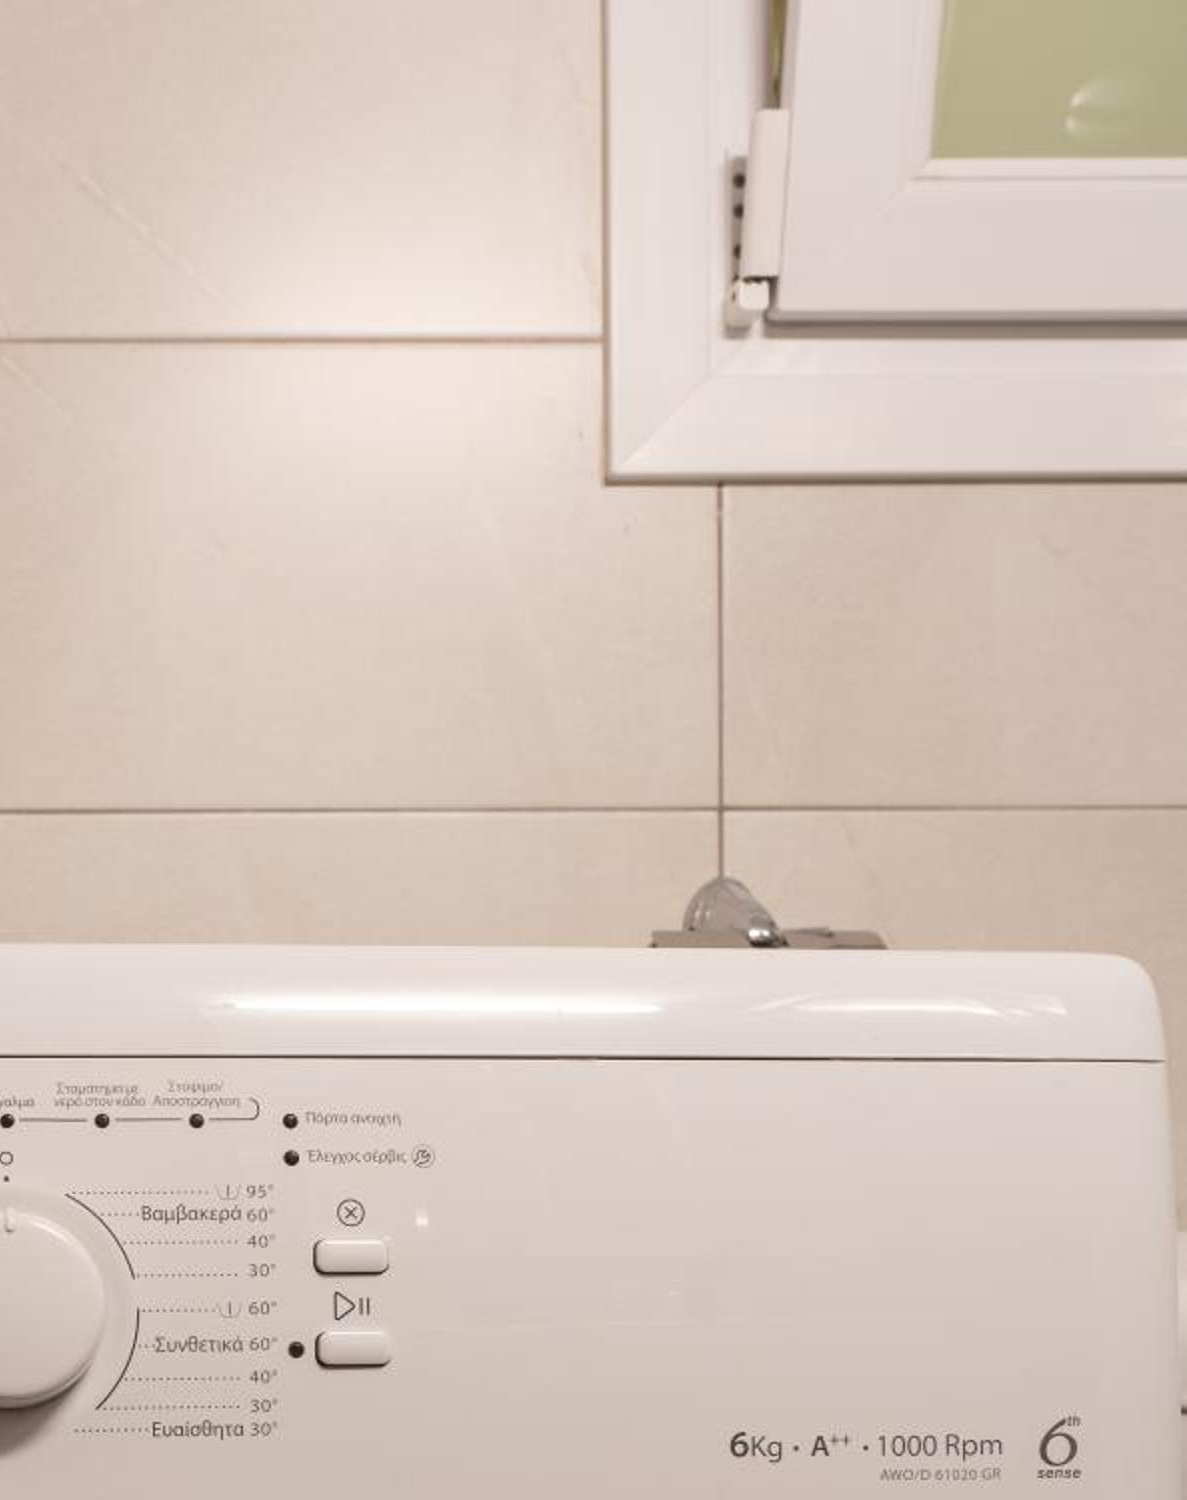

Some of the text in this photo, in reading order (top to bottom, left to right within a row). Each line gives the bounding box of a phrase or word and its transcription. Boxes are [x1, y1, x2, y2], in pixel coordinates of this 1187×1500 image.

[246, 1184, 274, 1199] 95°
[141, 1205, 275, 1224] Βαμβακερά 60°
[247, 1234, 276, 1249] 40°
[249, 1263, 276, 1278] 30°
[248, 1300, 278, 1315] 60°
[155, 1336, 278, 1353] Συνθετικά 60°
[249, 1370, 278, 1385] 40°
[250, 1399, 278, 1413] 30°
[151, 1421, 279, 1441] Ευαίσθητα 30°
[730, 1431, 1003, 1462] 6Kg A++ 1000 Rpm
[880, 1468, 931, 1481] AWO/D
[982, 1468, 1001, 1480] GR
[1036, 1467, 1082, 1480] sense
